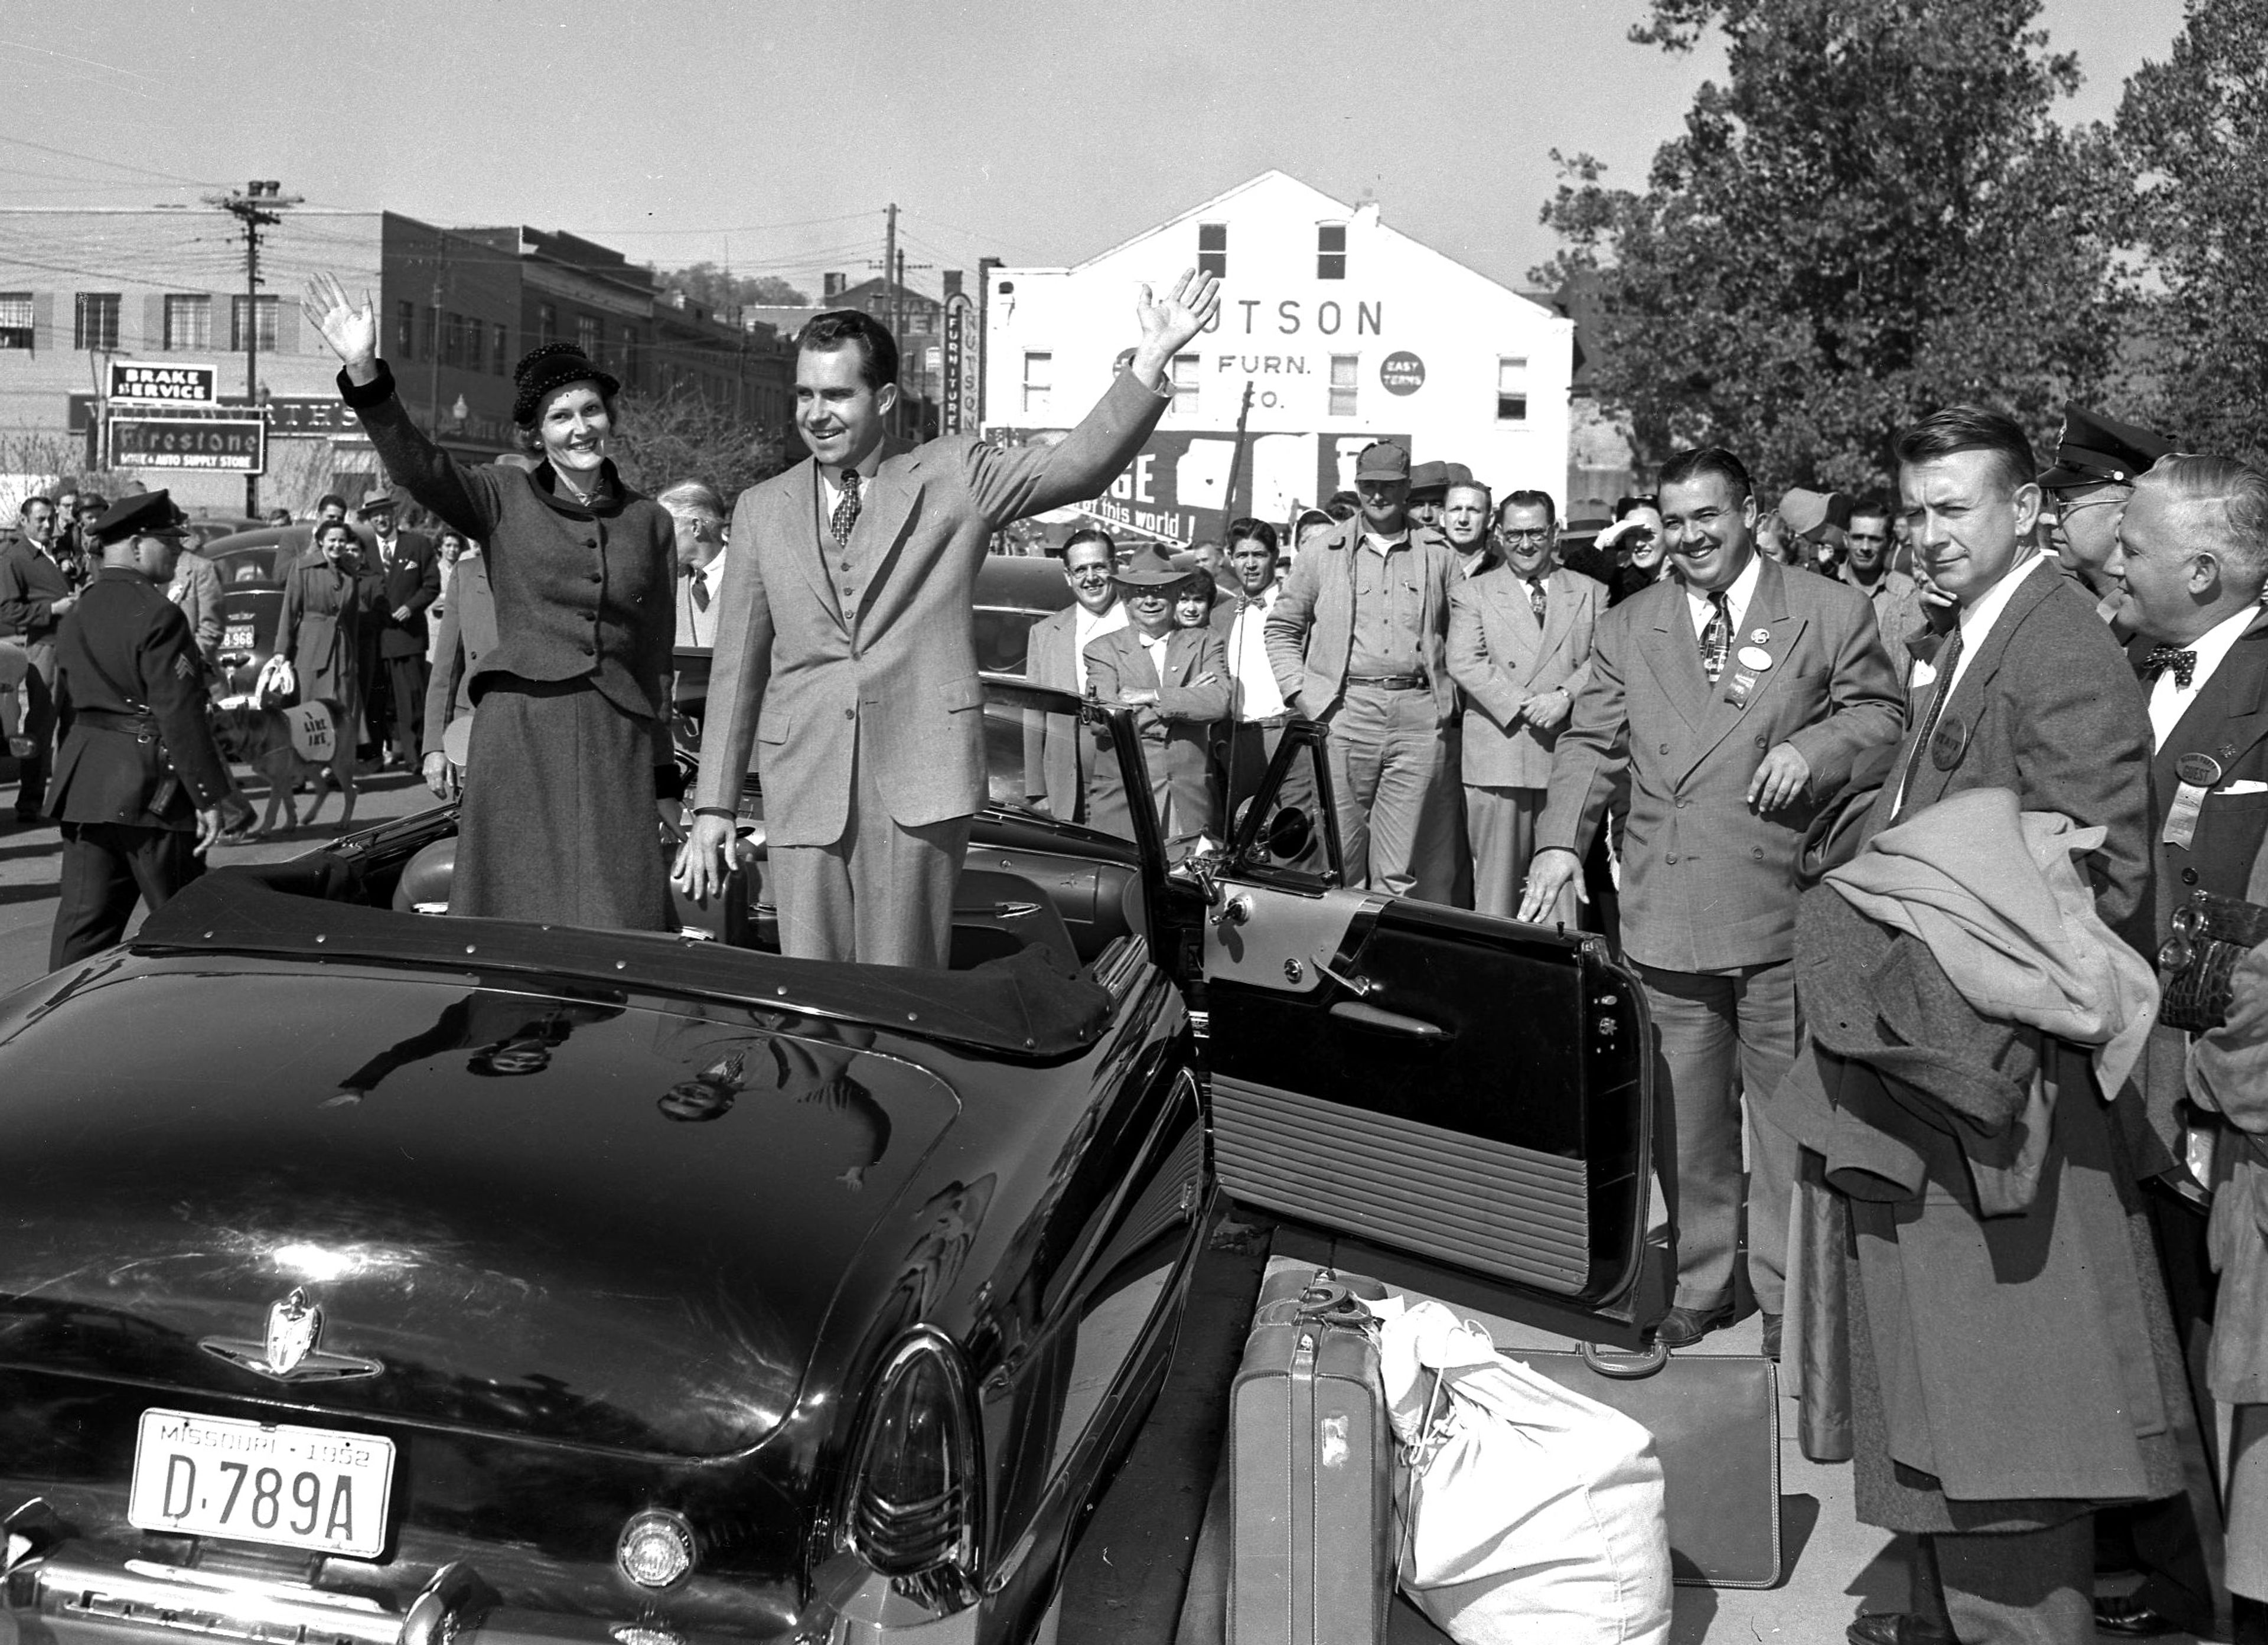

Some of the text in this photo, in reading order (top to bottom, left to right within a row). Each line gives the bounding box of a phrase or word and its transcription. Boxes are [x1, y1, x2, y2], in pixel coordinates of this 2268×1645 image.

[1203, 300, 1381, 335] UTSON
[947, 317, 958, 425] FURNITURE
[964, 314, 977, 431] HUTSON
[1218, 356, 1311, 374] FURN.
[1387, 361, 1418, 372] EASY
[126, 369, 198, 385] BRAKE
[1384, 375, 1422, 386] TERMS
[118, 383, 204, 399] SERVICE
[117, 424, 256, 452] Firestone
[155, 454, 181, 467] AUTO
[183, 455, 217, 467] SUPPLY
[220, 456, 251, 468] STORE
[1102, 498, 1129, 523] this
[304, 718, 327, 732] LIKE
[160, 1425, 276, 1454] MISSOURI
[306, 1444, 370, 1467] 1952
